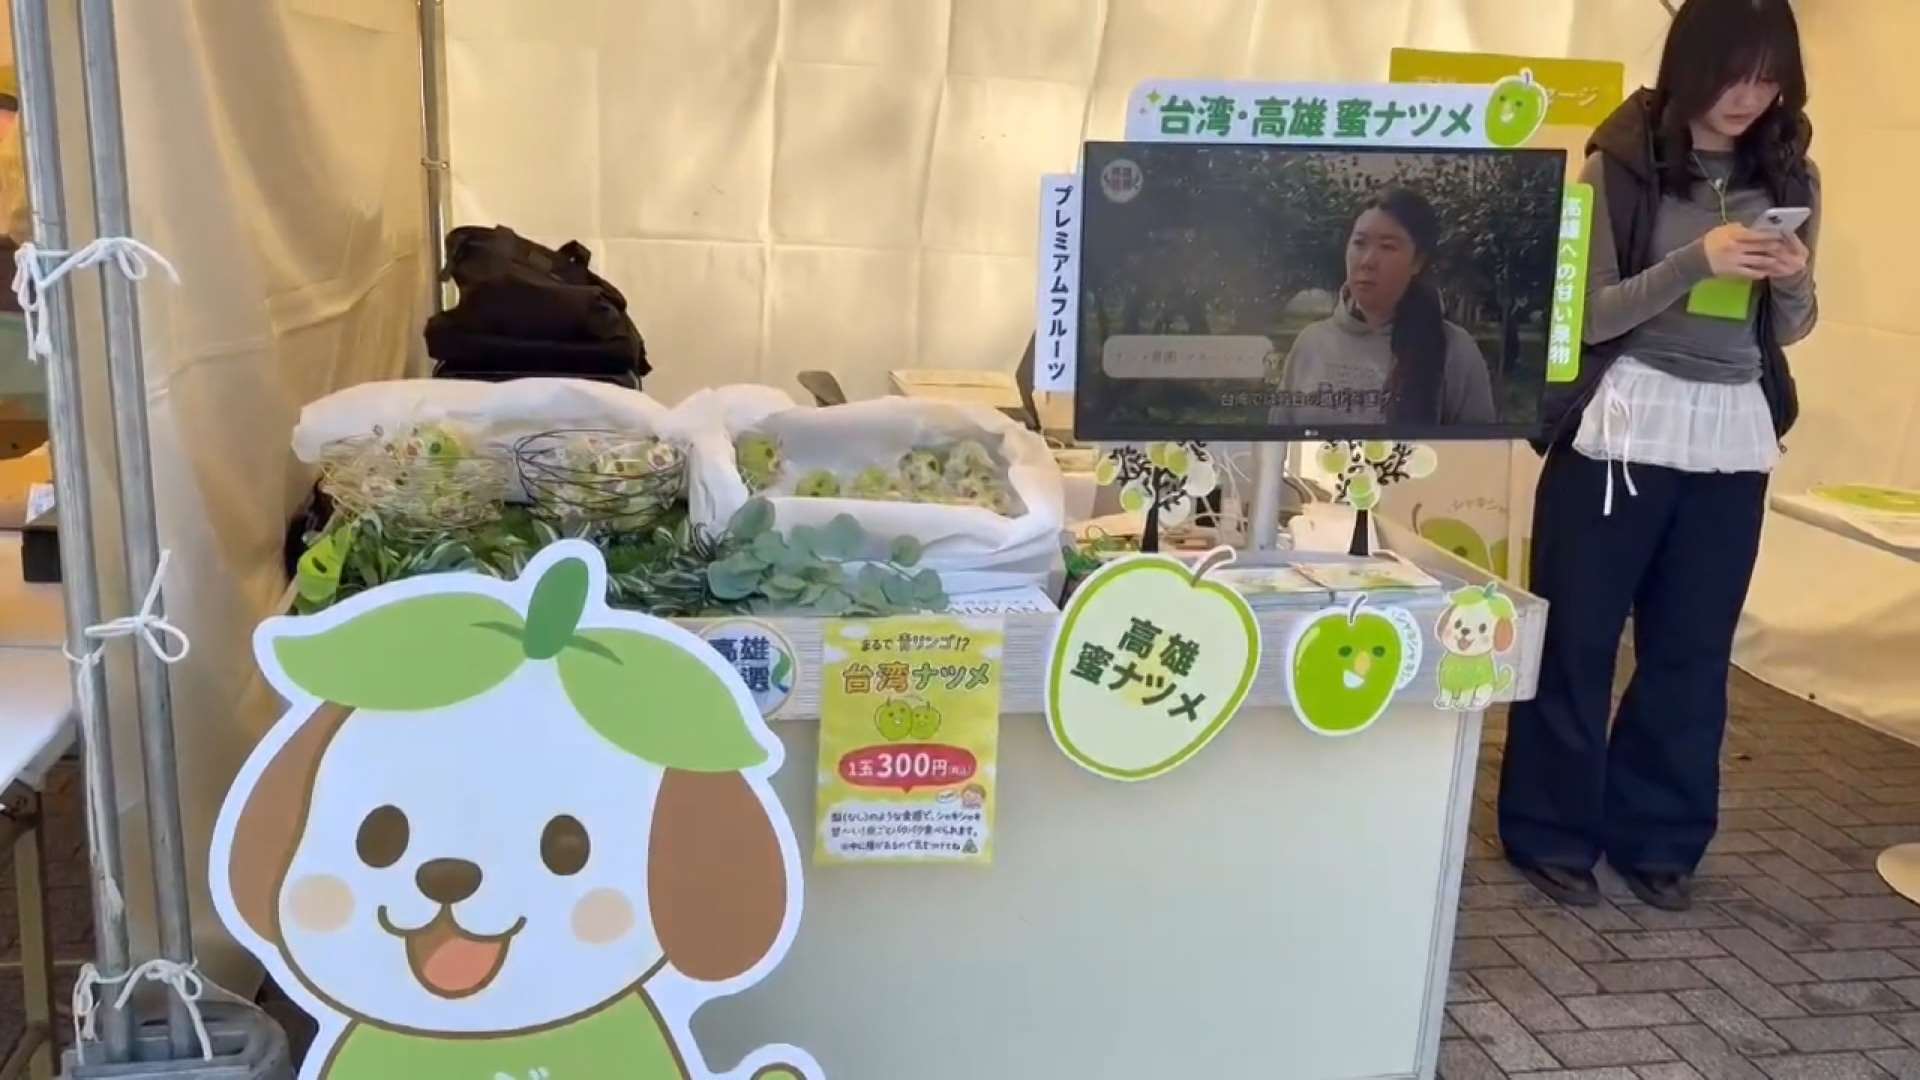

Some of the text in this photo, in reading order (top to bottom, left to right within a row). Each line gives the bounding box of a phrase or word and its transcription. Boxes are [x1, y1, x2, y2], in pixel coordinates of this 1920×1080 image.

[1160, 95, 1474, 138] 台湾・高雄 蜜ナツメ
[1048, 185, 1074, 380] プレミアムフルーツ
[861, 638, 893, 652] まるで
[1118, 616, 1200, 677] 高雄
[842, 661, 990, 695] 台湾ナツメ
[1070, 641, 1206, 722] 蜜ナツメ
